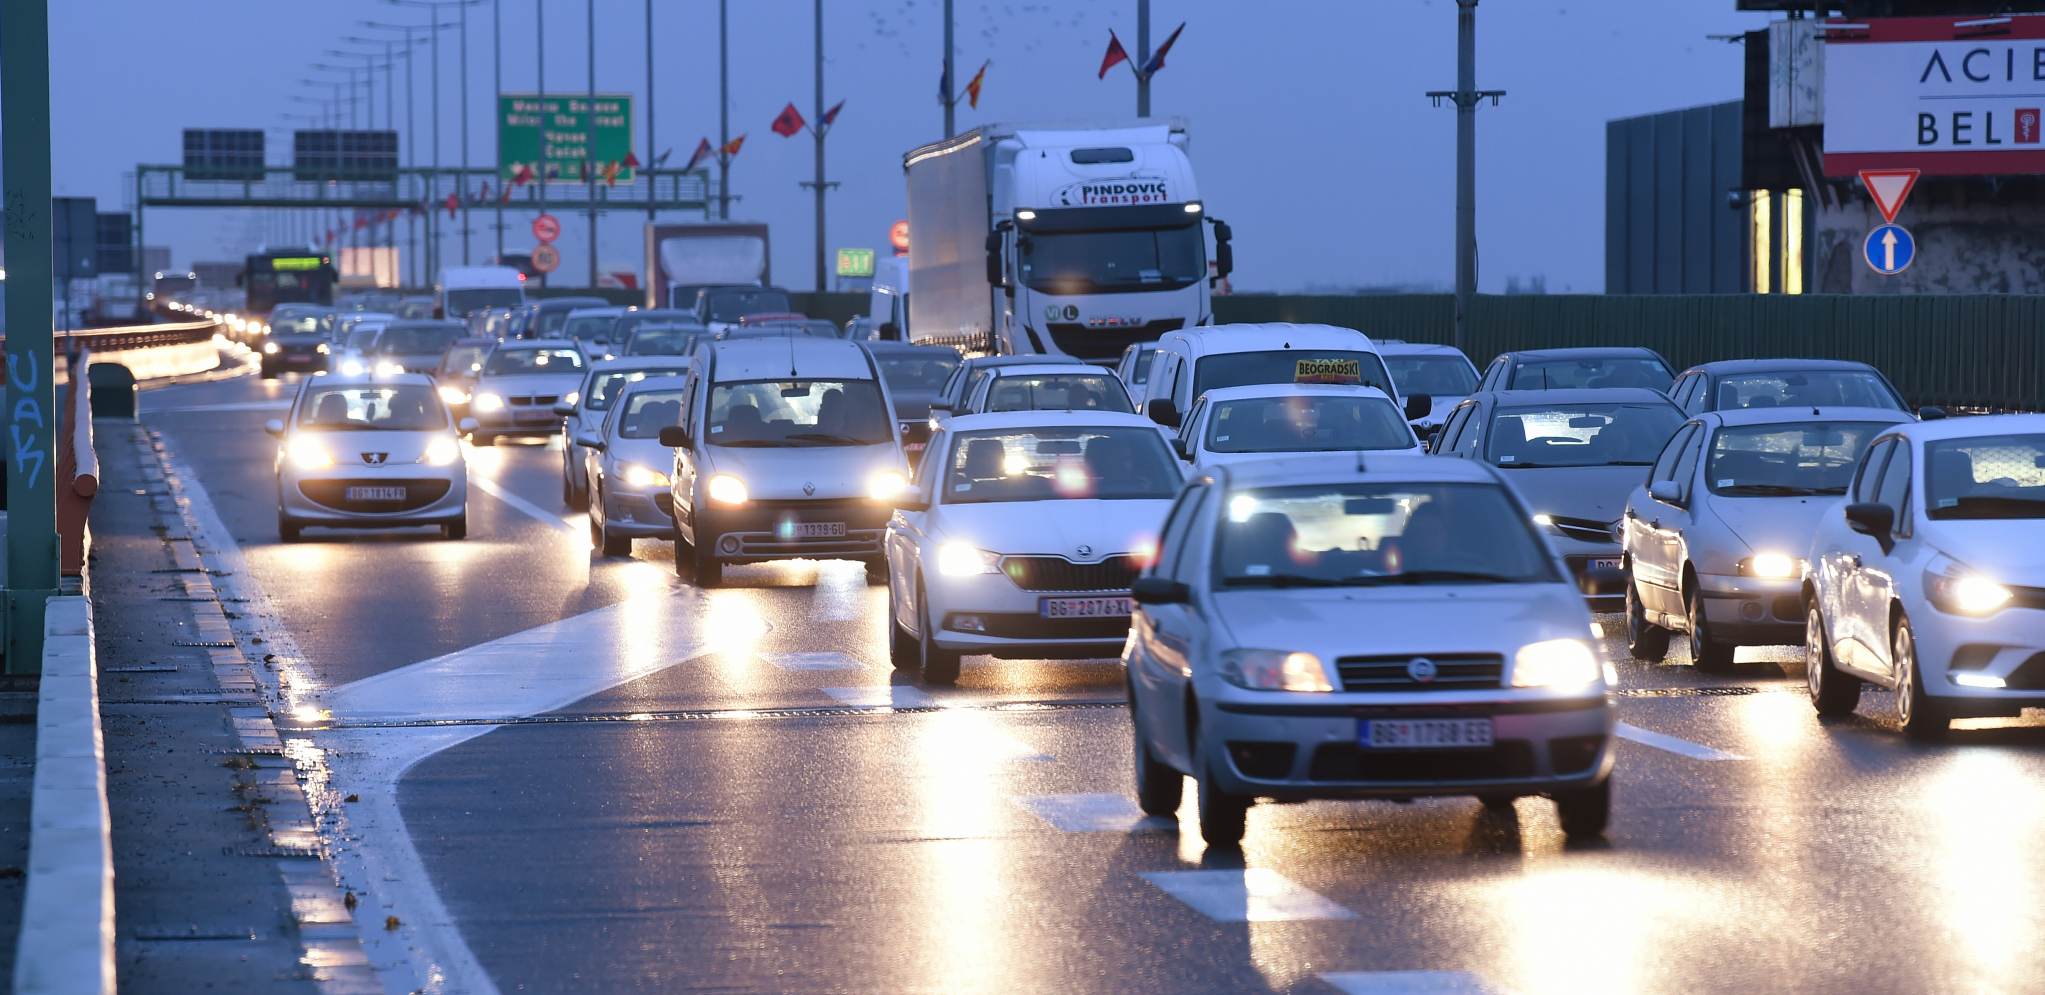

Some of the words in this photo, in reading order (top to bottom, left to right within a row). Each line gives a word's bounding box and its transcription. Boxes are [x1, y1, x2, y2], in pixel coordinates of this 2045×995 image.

[1918, 111, 2002, 145] BEL
[1082, 180, 1166, 195] PINDOVIĆ
[1066, 306, 1075, 319] L
[1299, 362, 1359, 375] BEOGRADSKI
